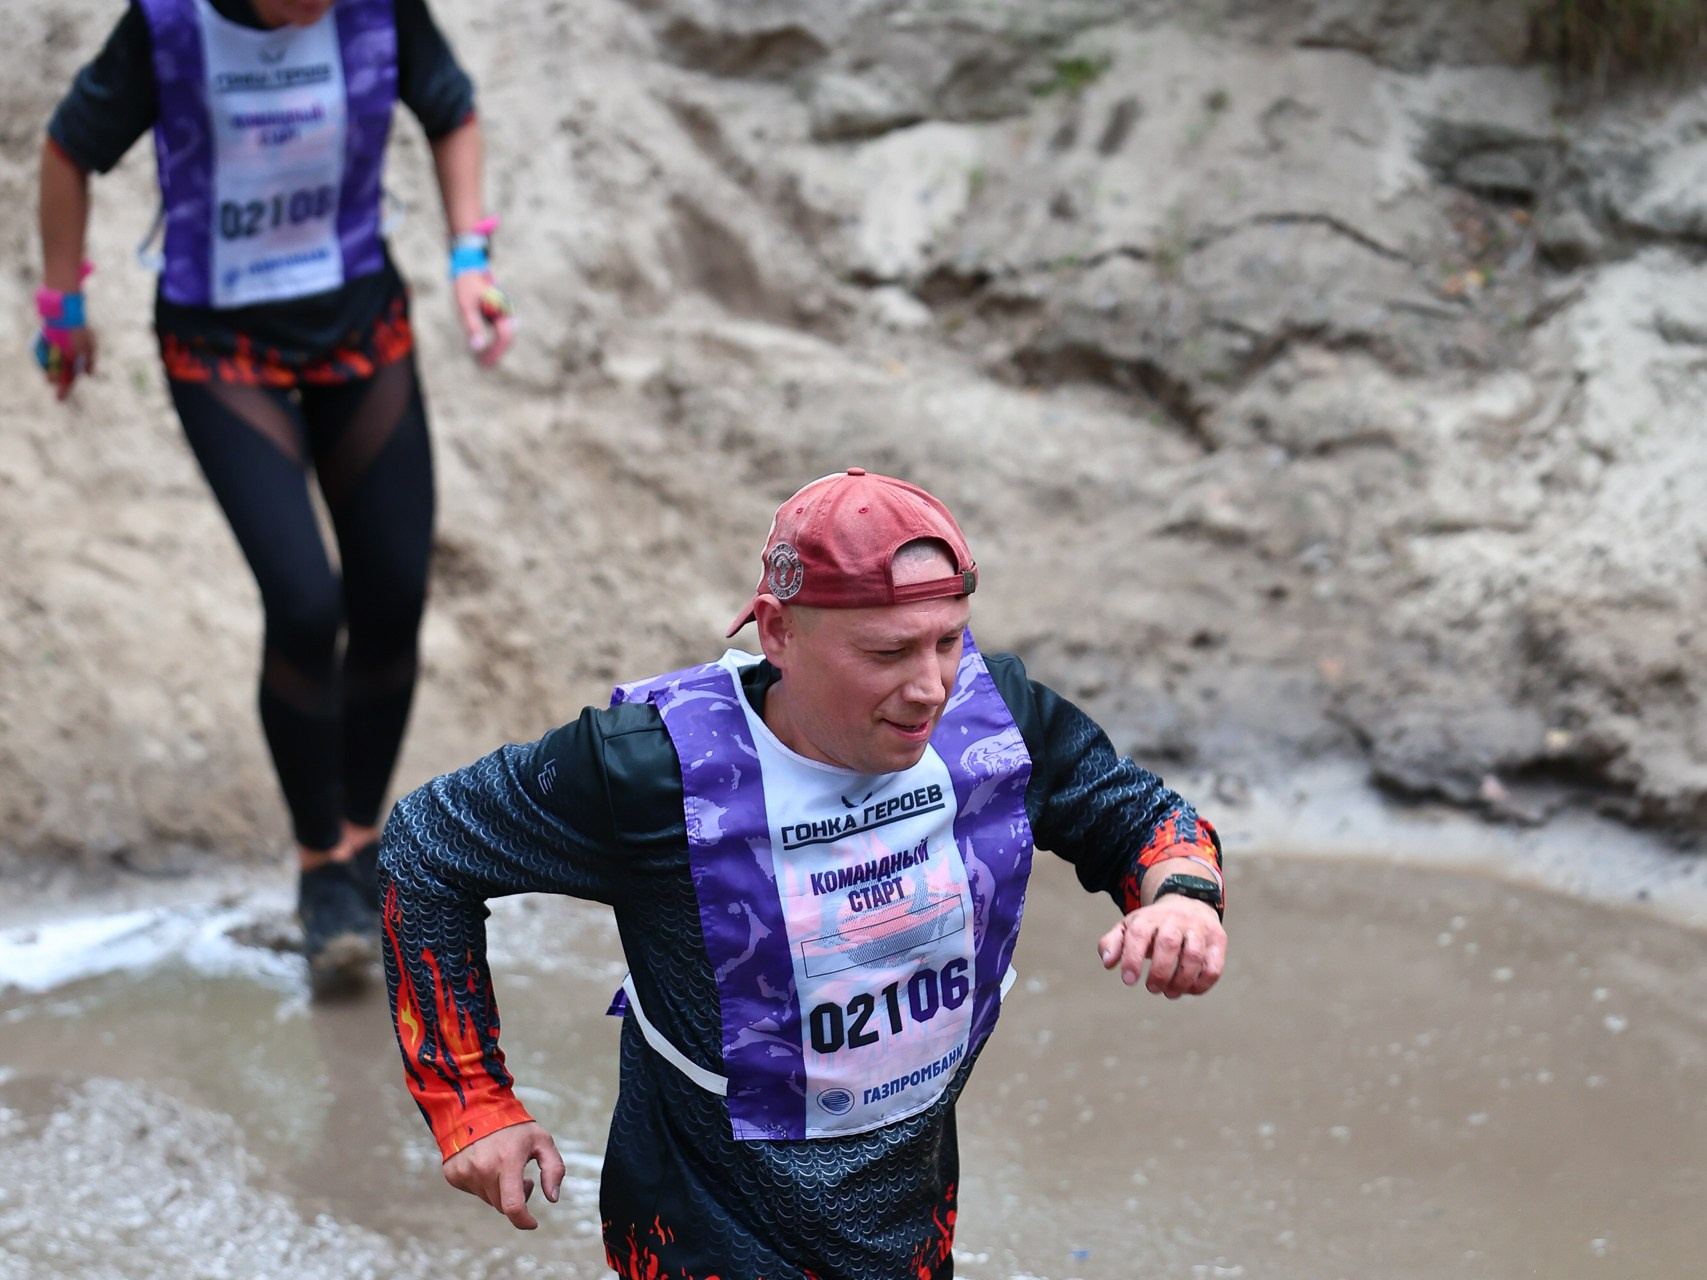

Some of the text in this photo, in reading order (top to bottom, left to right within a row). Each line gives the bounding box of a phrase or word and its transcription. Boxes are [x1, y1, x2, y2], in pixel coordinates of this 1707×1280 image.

[781, 783, 943, 843] ГОНКА ГЕРОЕВ
[810, 836, 930, 896] КОМАНДНЫЙ
[848, 877, 906, 912] СТАРТ
[809, 957, 969, 1054] 02106
[863, 1043, 964, 1105] ГАЗПРОМБАНК
